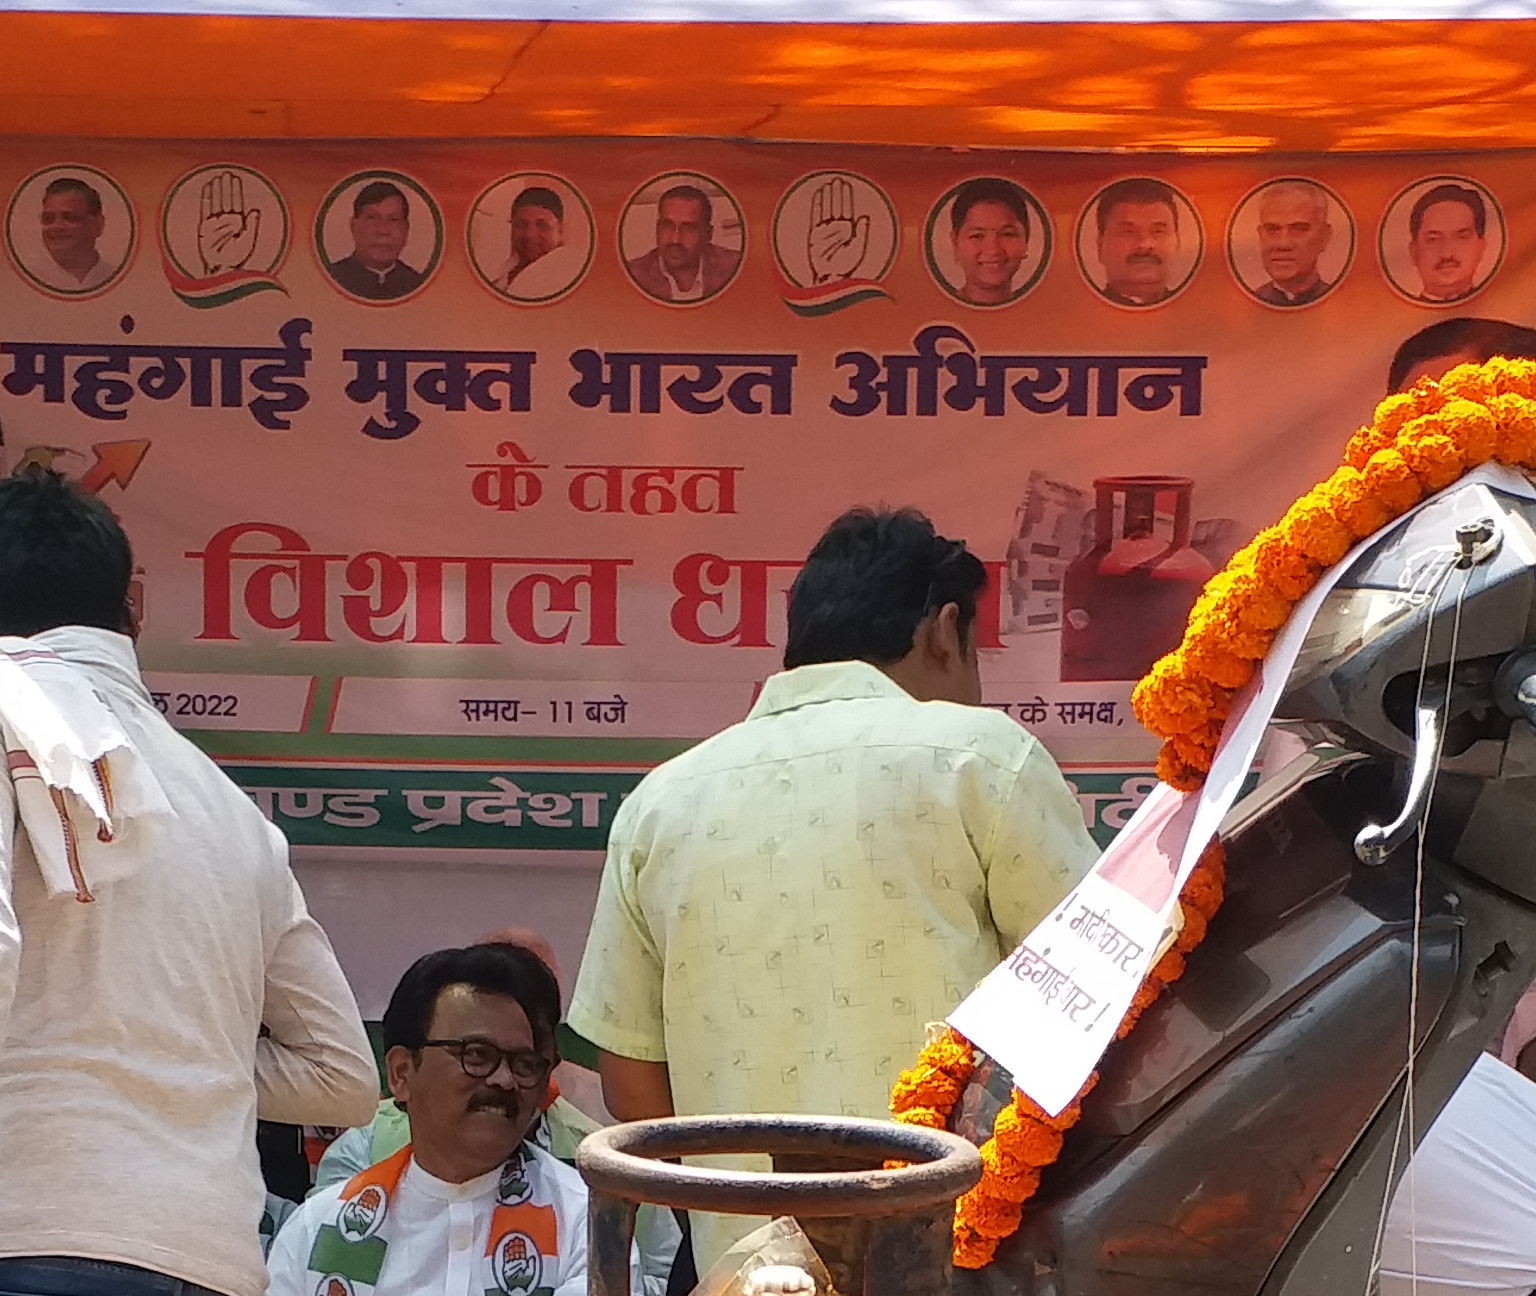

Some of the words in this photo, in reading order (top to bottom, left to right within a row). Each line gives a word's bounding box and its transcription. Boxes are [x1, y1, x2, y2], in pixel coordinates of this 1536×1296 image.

[0, 315, 313, 430] महंगाई
[343, 349, 535, 440] मुक्त
[569, 349, 797, 416] भारत
[830, 325, 1208, 417] अभियान
[465, 441, 549, 512] के
[564, 464, 745, 516] तहत
[184, 521, 634, 649] विशाल
[175, 693, 238, 717] 2022
[549, 701, 573, 723] 11
[583, 694, 628, 723] बजे
[1017, 695, 1049, 725] के
[402, 776, 607, 834] प्रदेश
